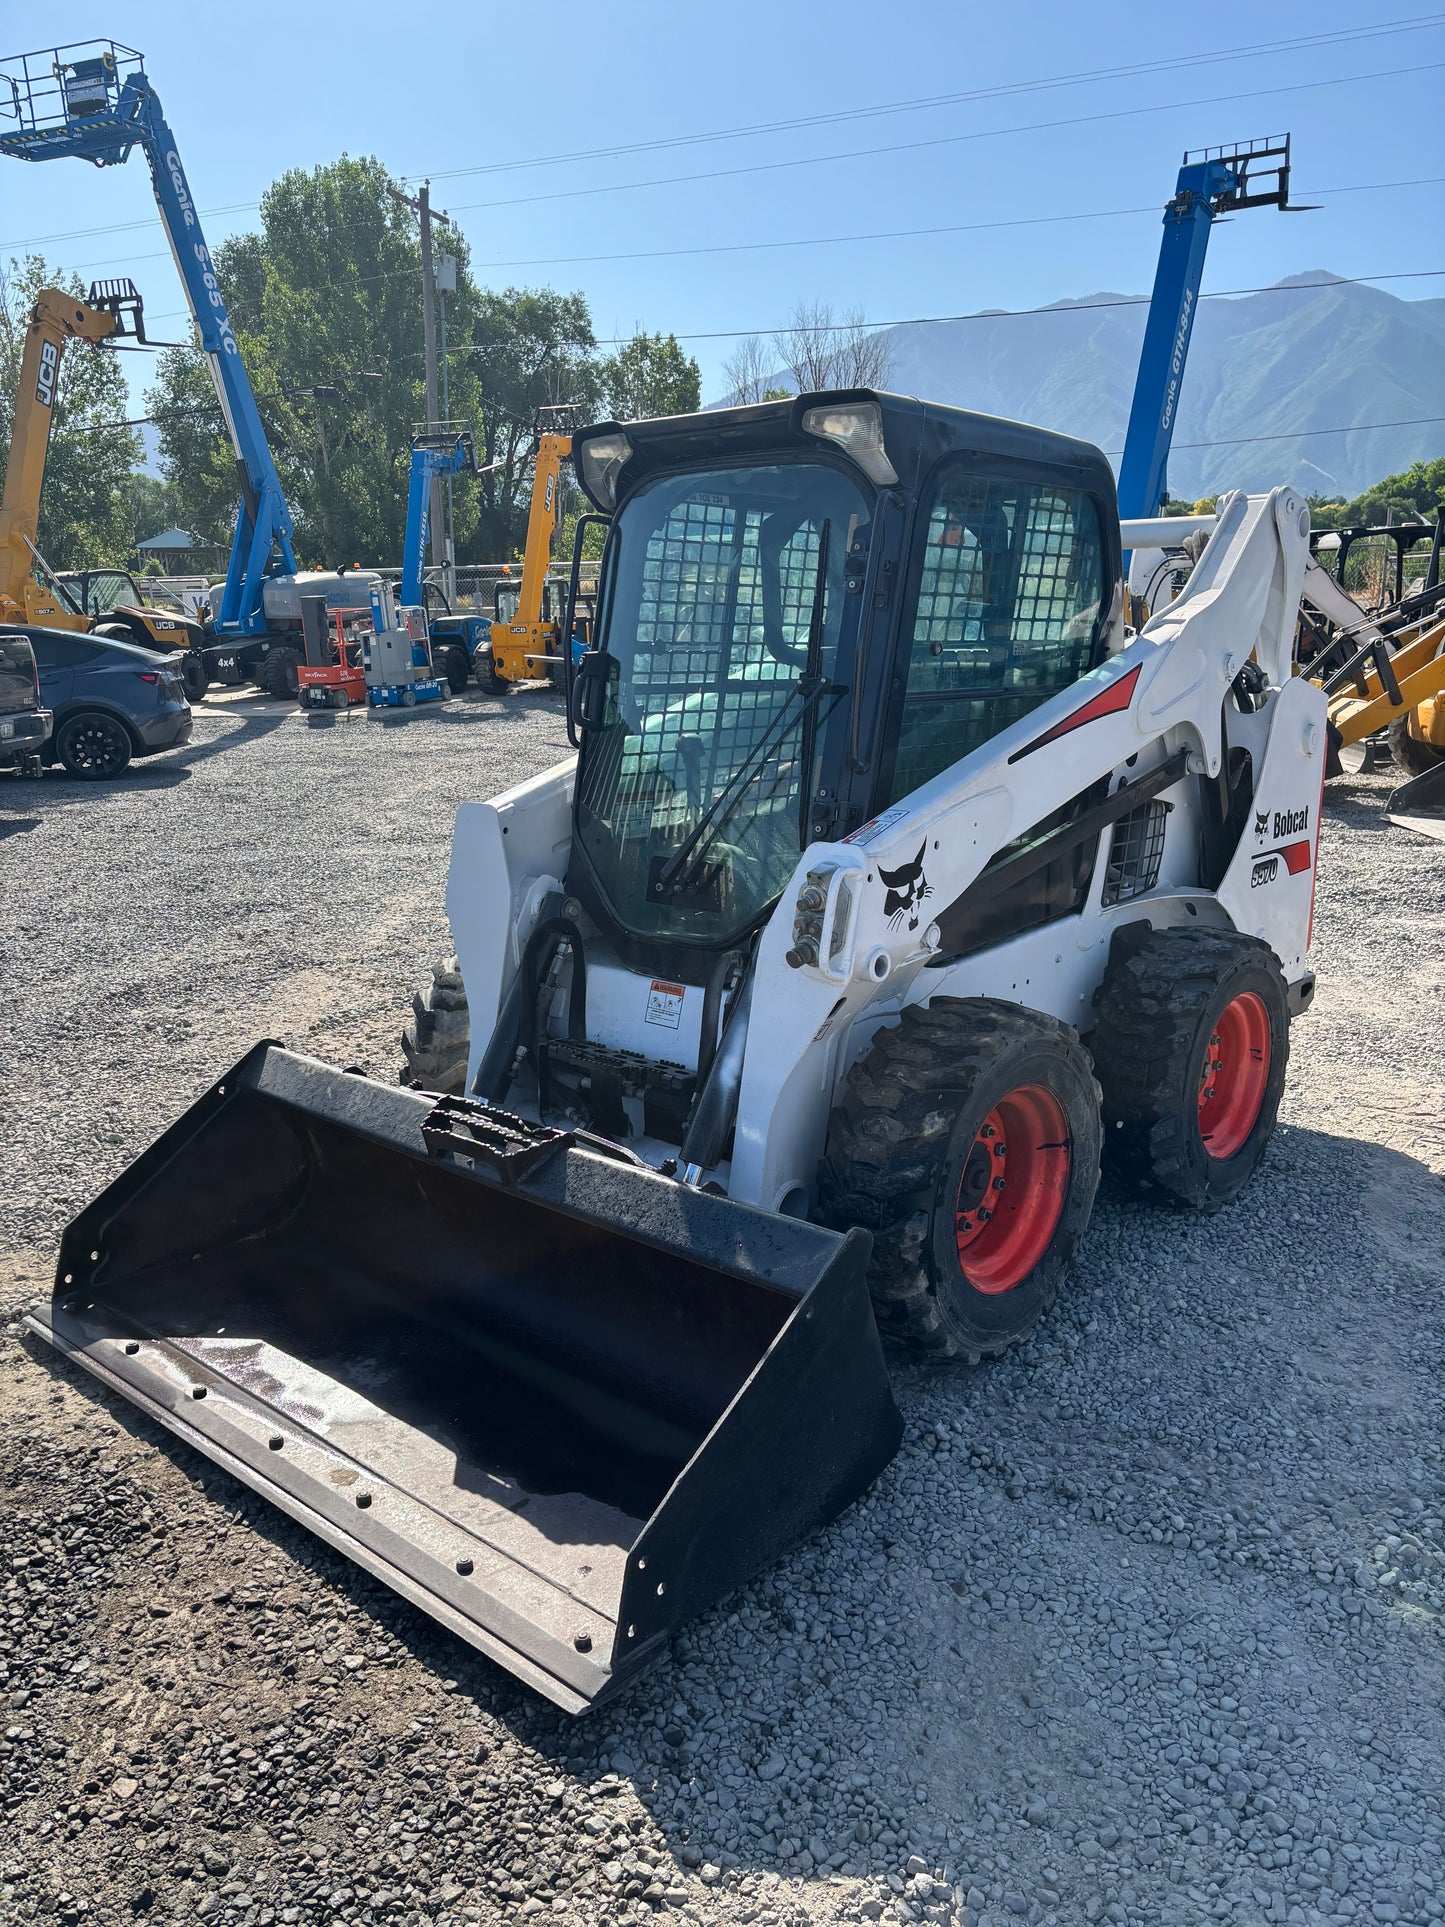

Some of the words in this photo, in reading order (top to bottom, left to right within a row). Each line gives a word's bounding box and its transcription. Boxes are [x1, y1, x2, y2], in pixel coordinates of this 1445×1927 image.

[166, 150, 194, 227] Genie
[193, 242, 223, 308] S-65
[215, 315, 238, 355] XC
[36, 341, 58, 406] JCB
[1162, 379, 1177, 430] Genie
[1172, 287, 1193, 375] GTH-844
[544, 474, 554, 511] JCB
[155, 621, 176, 630] JCB
[217, 657, 235, 667] 4x4
[1273, 804, 1309, 839] Bobcat
[1251, 857, 1278, 888] S570
